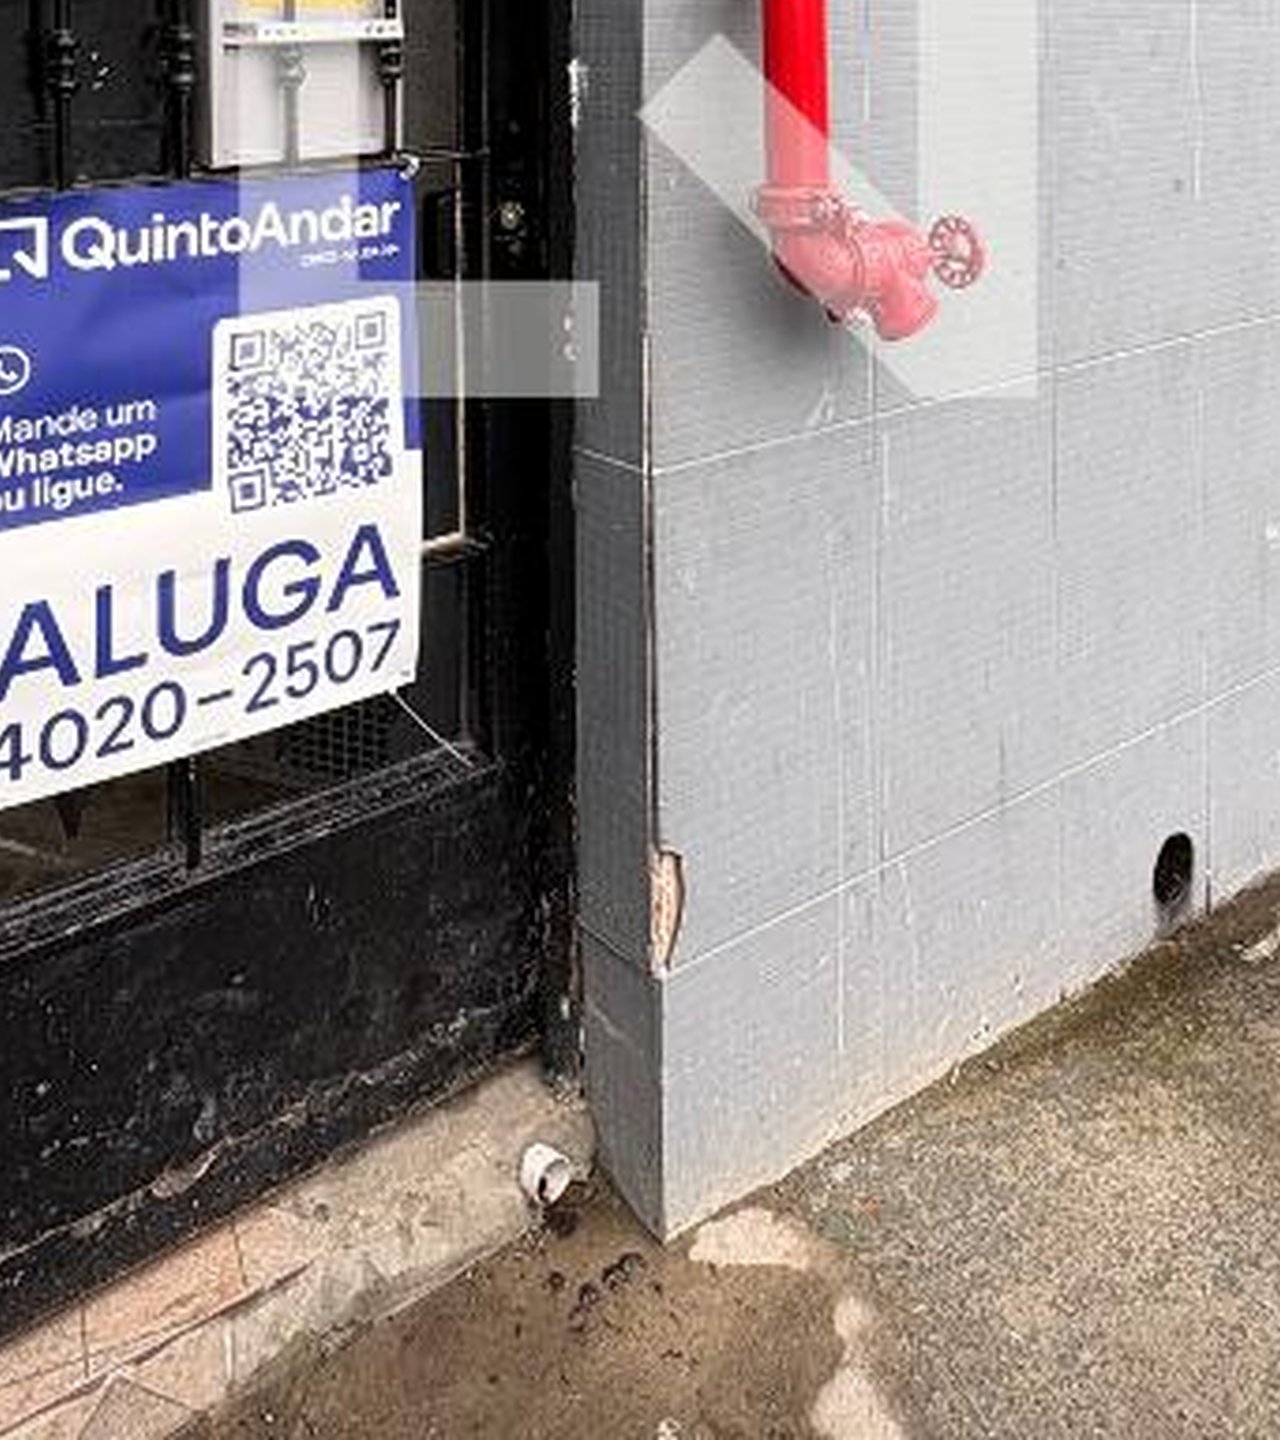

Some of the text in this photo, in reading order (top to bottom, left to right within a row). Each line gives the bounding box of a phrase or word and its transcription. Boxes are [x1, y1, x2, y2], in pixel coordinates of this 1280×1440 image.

[61, 194, 402, 270] QuintoAndar
[105, 398, 157, 425] um
[33, 470, 124, 510] ligue.
